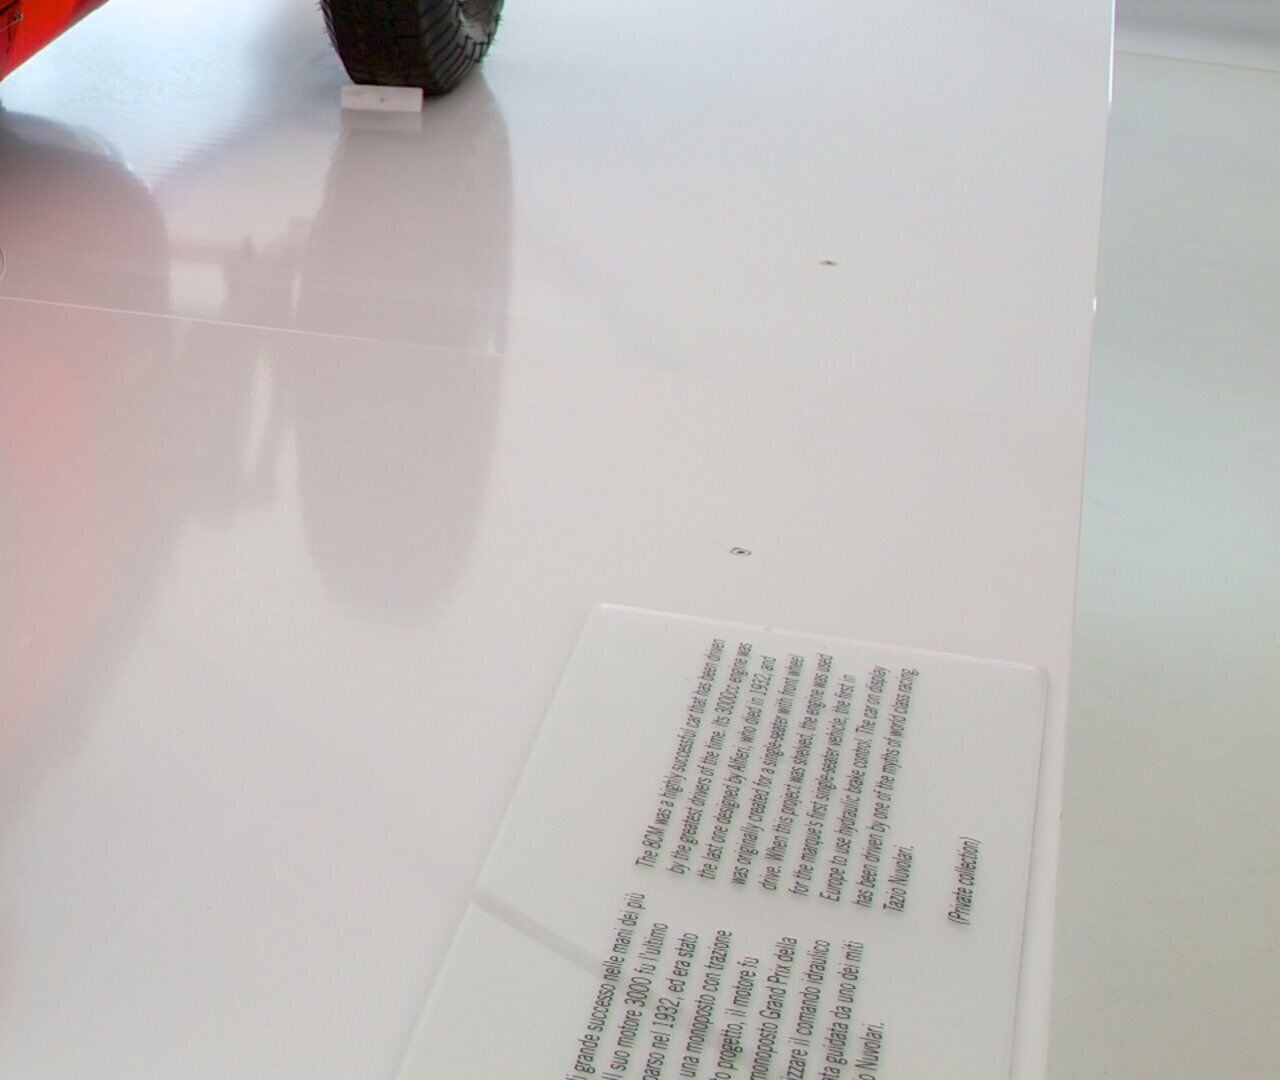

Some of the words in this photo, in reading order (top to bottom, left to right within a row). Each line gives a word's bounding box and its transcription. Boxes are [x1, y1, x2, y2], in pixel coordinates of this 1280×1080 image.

[704, 638, 725, 662] driven
[737, 642, 752, 658] was
[700, 662, 718, 682] been
[728, 658, 749, 684] engine
[760, 656, 776, 672] and
[787, 654, 804, 677] wheel
[817, 653, 833, 673] used
[778, 677, 799, 697] front
[813, 673, 829, 689] was
[843, 674, 856, 683] in
[867, 666, 891, 694] display
[693, 682, 712, 697] has
[715, 684, 740, 715] 3000cc
[836, 683, 855, 700] first
[868, 694, 881, 705] on
[688, 696, 708, 714] that
[751, 697, 764, 706] in
[776, 697, 794, 715] with
[806, 688, 826, 716] engine
[832, 700, 851, 715] the
[893, 693, 910, 714] class
[686, 714, 701, 728] car
[711, 715, 731, 728] Its
[742, 706, 762, 726] died
[864, 705, 878, 720] car
[799, 716, 818, 731] the
[857, 719, 876, 735] The
[889, 714, 907, 738] world
[738, 726, 757, 744] who
[763, 715, 788, 768] single-seater
[886, 737, 902, 748] of
[700, 751, 720, 766] the
[882, 748, 902, 775] myths
[698, 764, 715, 776] of
[724, 772, 747, 784] by
[761, 767, 775, 775] a
[789, 766, 806, 784] was
[815, 746, 840, 801] single-seater
[660, 772, 687, 800] highly
[688, 776, 712, 807] drivers
[754, 774, 772, 789] for
[845, 770, 866, 794] brake
[876, 775, 895, 791] the
[660, 800, 674, 808] a
[713, 784, 740, 825] designed
[748, 788, 770, 822] created
[780, 784, 802, 816] project
[875, 790, 892, 802] of
[655, 808, 672, 826] was
[807, 801, 828, 820] first
[835, 795, 861, 837] hydraulic
[874, 802, 890, 820] one
[679, 807, 704, 846] greatest
[711, 825, 729, 844] one
[772, 816, 794, 834] this
[869, 820, 891, 833] by
[642, 825, 664, 850] 8CM
[736, 822, 765, 865] originally
[835, 837, 852, 855] use
[670, 844, 692, 861] the
[702, 843, 724, 862] last
[765, 835, 788, 862] When
[862, 833, 883, 863] driven
[636, 850, 658, 868] The
[666, 860, 691, 875] by
[828, 855, 848, 866] to
[889, 846, 914, 887] Nuvolari.
[956, 836, 981, 886] collection)
[697, 863, 718, 880] the
[731, 866, 749, 885] was
[793, 864, 814, 881] the
[856, 864, 878, 889] been
[789, 880, 809, 897] for
[820, 867, 848, 902] Europe
[627, 892, 646, 910] più
[852, 888, 874, 908] has
[884, 887, 907, 912] Tazio
[948, 887, 973, 925] (Private
[619, 910, 639, 926] dei
[612, 928, 634, 954] mani
[676, 933, 698, 959] stato
[704, 930, 732, 970] trazione
[776, 937, 797, 962] della
[845, 940, 863, 962] miti
[603, 955, 625, 982] nelle
[635, 963, 656, 975] fu
[673, 960, 691, 977] era
[739, 956, 759, 968] fu
[806, 940, 830, 985] idraulico
[703, 972, 721, 992] con
[770, 964, 791, 985] Prix
[840, 964, 859, 981] dei
[625, 976, 652, 1008] 3000
[667, 978, 686, 993] ed
[733, 970, 756, 1008] motore
[839, 982, 856, 1004] uno
[587, 983, 616, 1032] successo
[728, 1008, 747, 1018] il
[762, 986, 786, 1020] Grand
[796, 986, 821, 1036] comando
[833, 1005, 852, 1020] da
[617, 1010, 643, 1048] motore
[686, 994, 716, 1054] monoposto
[651, 1030, 671, 1050] nel
[717, 1022, 745, 1071] progetto,
[792, 1037, 811, 1047] il
[825, 1022, 849, 1066] guidata
[858, 1023, 884, 1072] Nuvolari.
[574, 1034, 600, 1074] grande
[610, 1050, 630, 1072] suo
[680, 1056, 700, 1078] una
